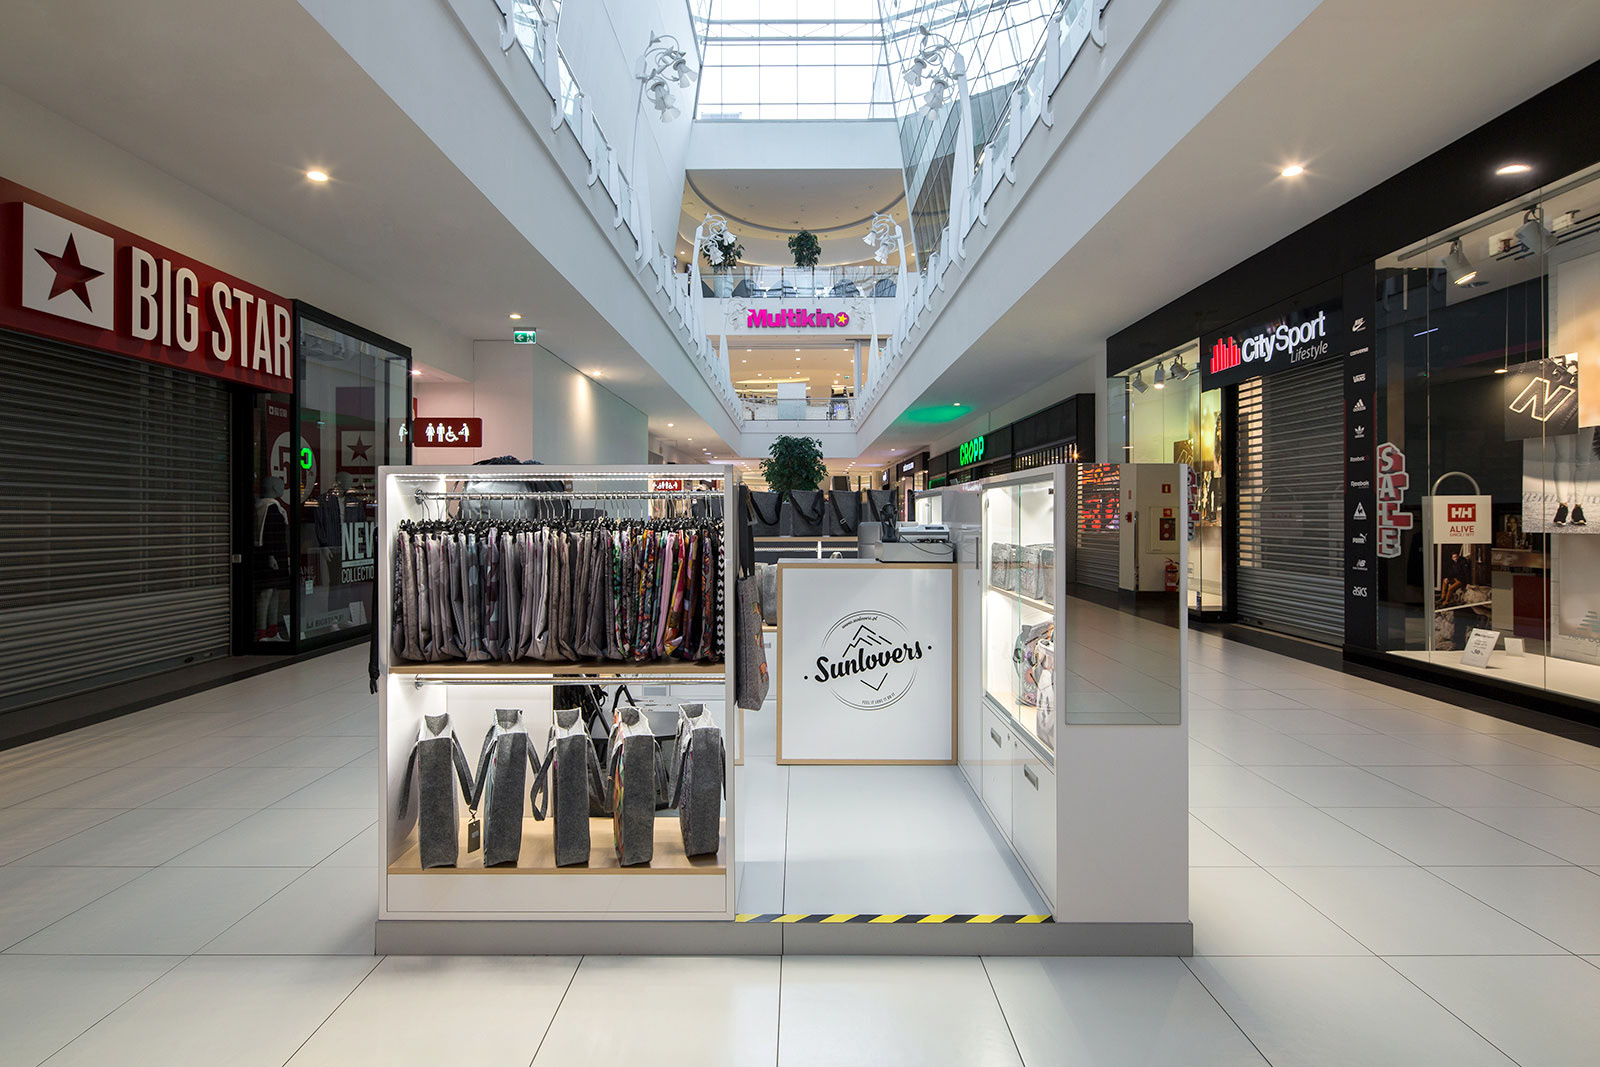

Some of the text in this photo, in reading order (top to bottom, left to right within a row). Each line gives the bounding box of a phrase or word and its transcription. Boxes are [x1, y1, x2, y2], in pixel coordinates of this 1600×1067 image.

[131, 246, 292, 380] BIG STAR
[1290, 341, 1329, 363] Lifestyle
[959, 436, 985, 466] CROPP
[1449, 525, 1475, 533] ALIVE
[341, 565, 375, 584] COLLECTIO
[814, 641, 922, 683] Sunlovers
